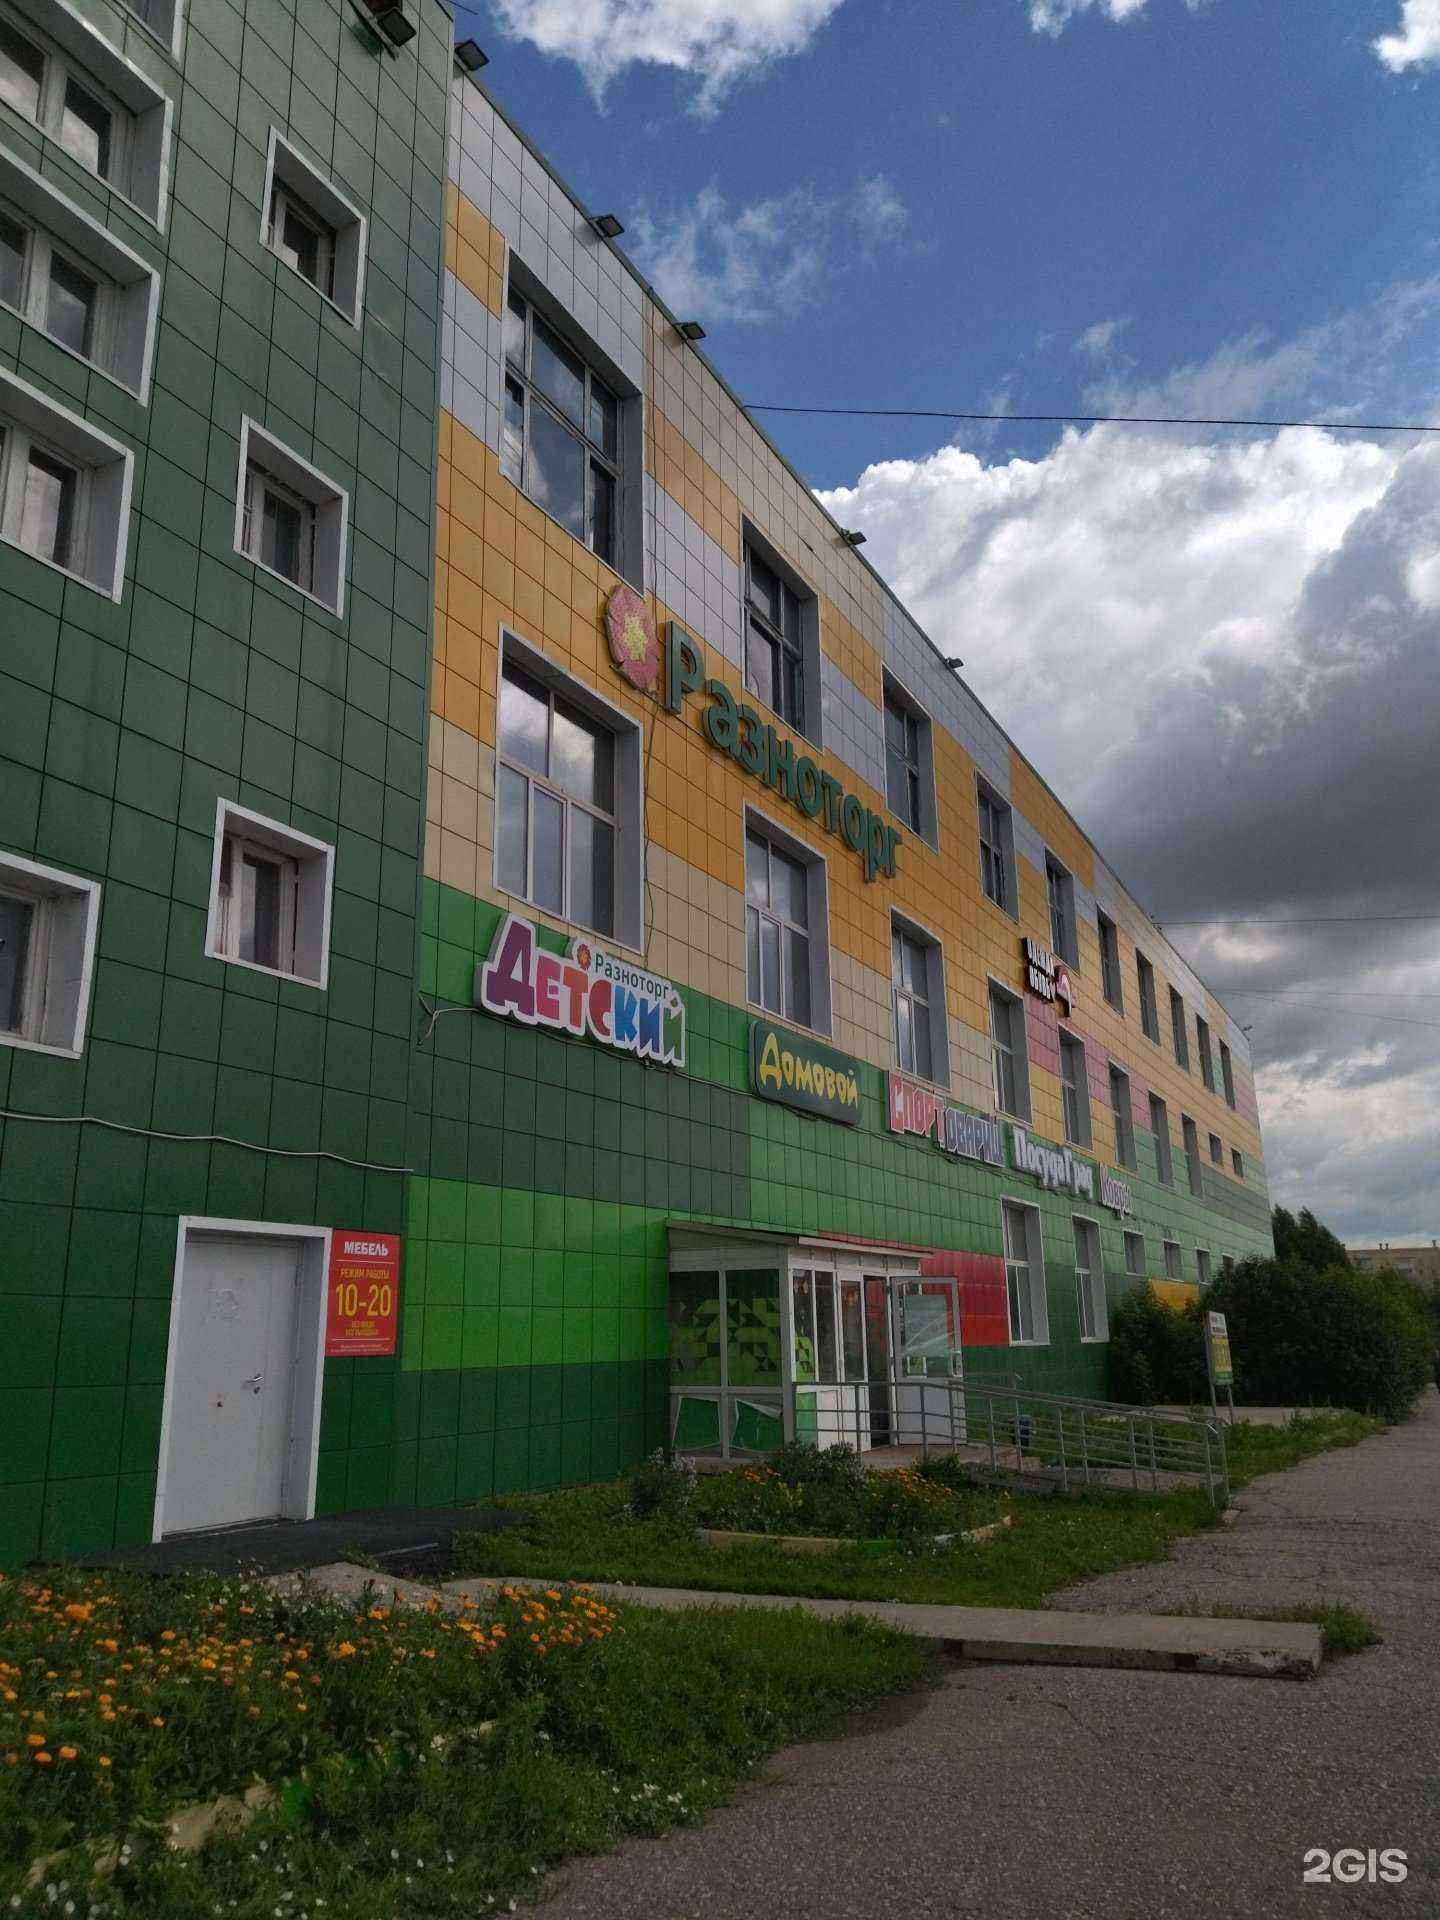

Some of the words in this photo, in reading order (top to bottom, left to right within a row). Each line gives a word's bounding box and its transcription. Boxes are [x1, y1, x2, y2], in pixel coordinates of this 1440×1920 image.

[665, 620, 902, 884] Разноторг
[594, 952, 669, 1000] Разноторг
[343, 1241, 389, 1257] МЕБЕЛЬ
[336, 1283, 392, 1317] 10-20
